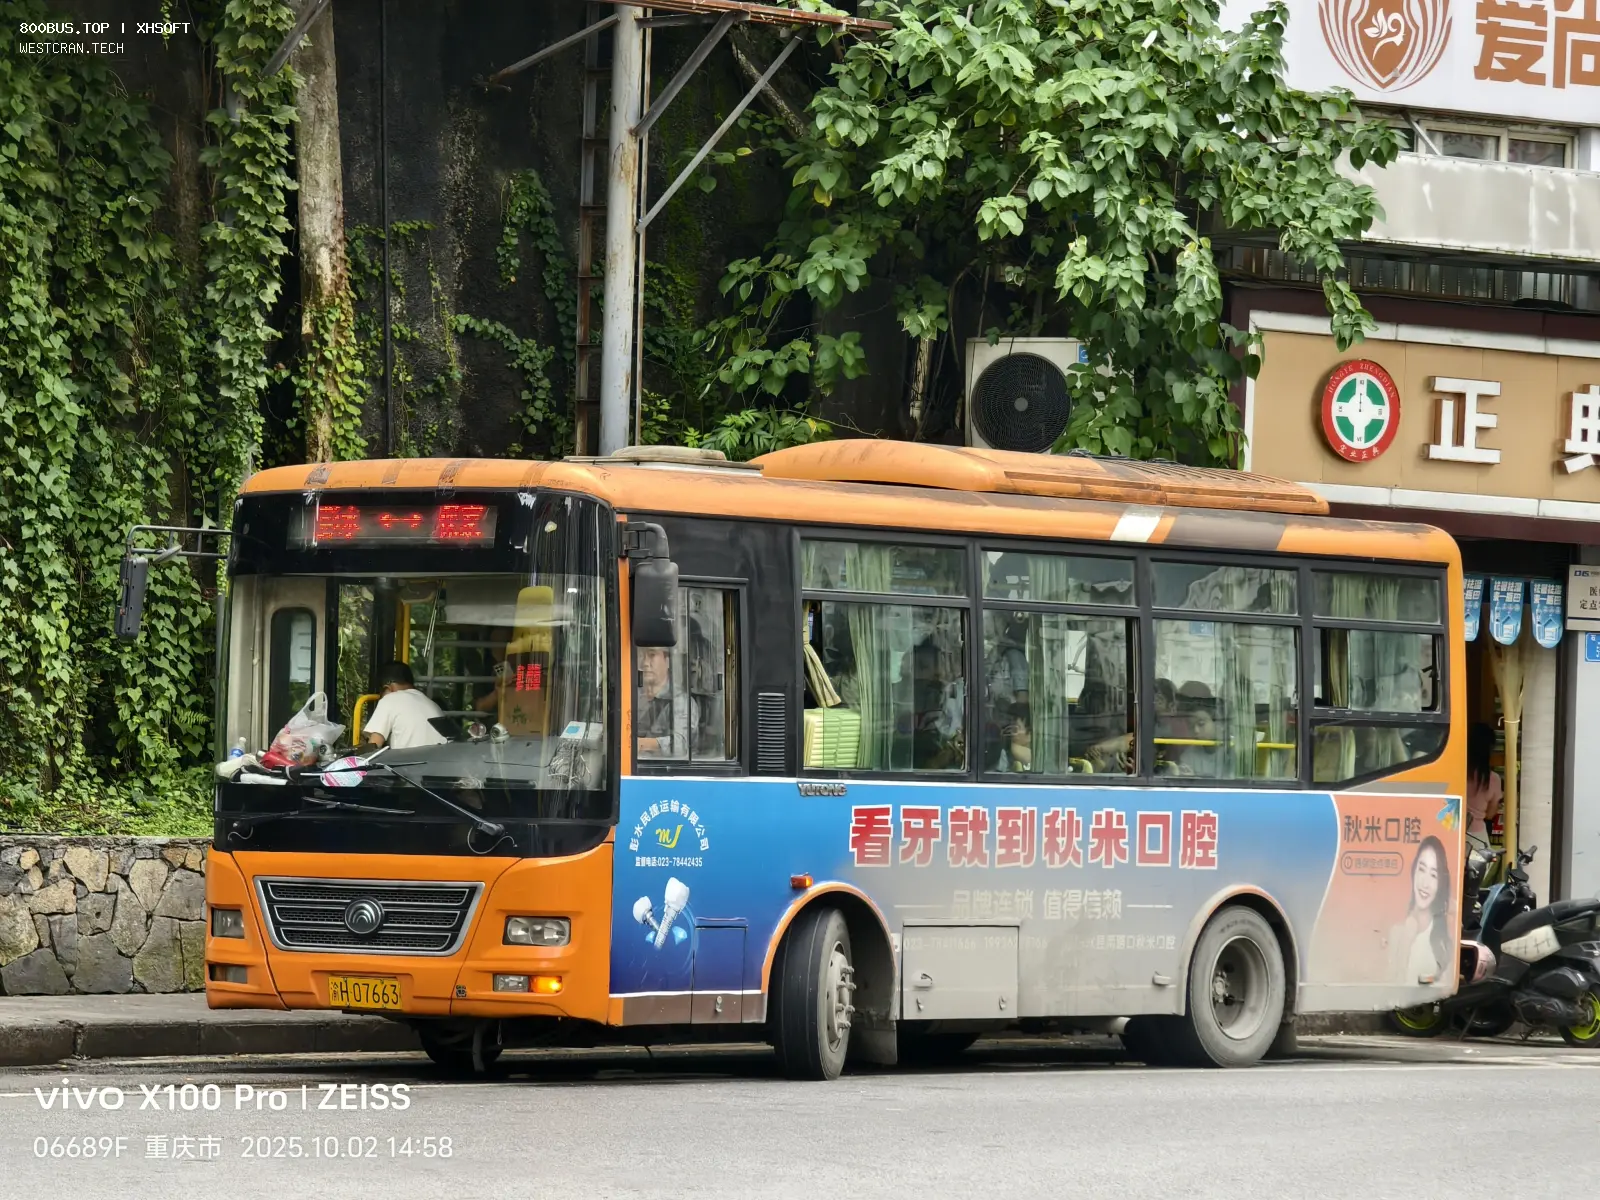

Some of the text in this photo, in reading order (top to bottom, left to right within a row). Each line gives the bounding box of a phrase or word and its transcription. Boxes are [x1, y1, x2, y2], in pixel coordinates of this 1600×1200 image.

[797, 782, 848, 797] YUTONG
[849, 805, 1220, 870] 看牙就到秋米口腔
[1344, 815, 1421, 844] 秋米口腔
[951, 888, 1122, 920] 品牌连锁 值得信赖
